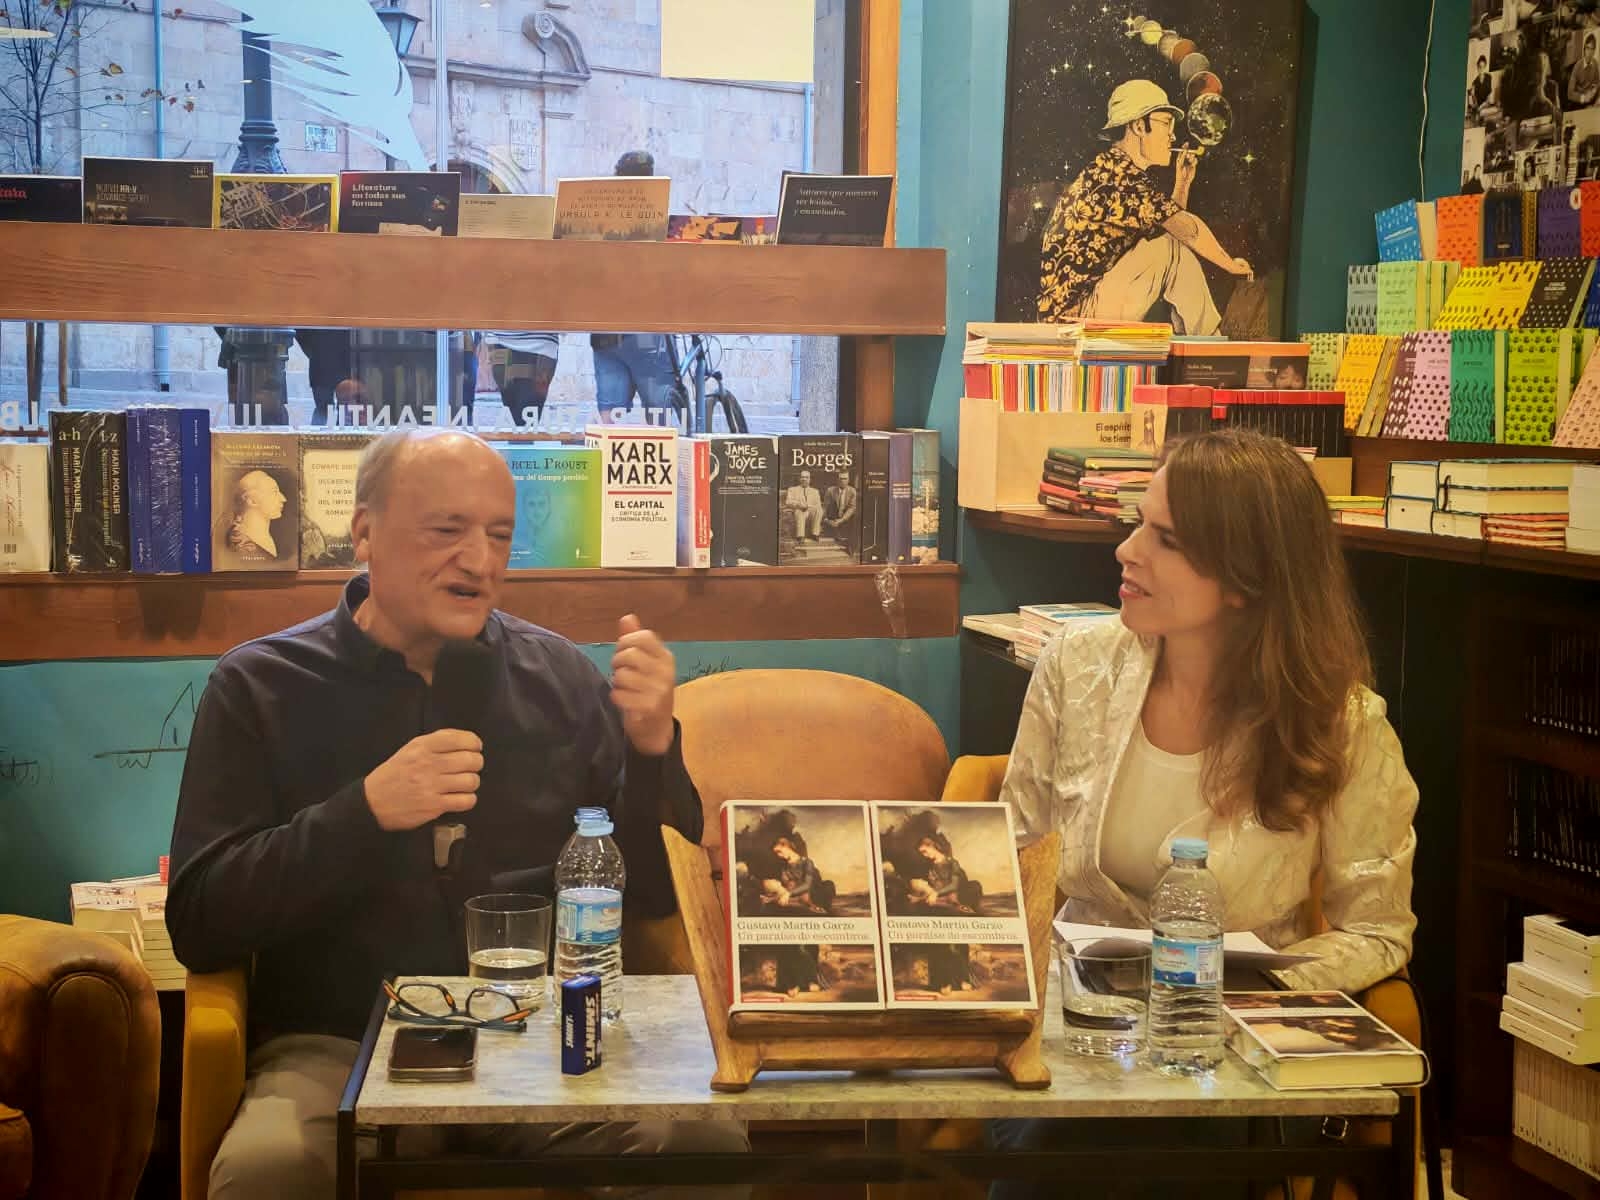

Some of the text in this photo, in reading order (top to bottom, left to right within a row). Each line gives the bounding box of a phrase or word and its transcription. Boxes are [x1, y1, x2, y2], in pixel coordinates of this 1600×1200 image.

[559, 208, 600, 217] URSULA
[620, 209, 633, 219] LE
[59, 427, 81, 441] a-h
[100, 430, 118, 443] i-z
[611, 442, 671, 463] KARL
[723, 441, 759, 456] JAMES
[729, 455, 768, 473] JOYCE
[791, 448, 853, 473] Borges
[607, 463, 673, 485] MARX
[112, 477, 121, 514] MOLINER
[614, 500, 665, 509] EL CAPITAL
[737, 920, 855, 930] Gustavo Martín Garzo
[887, 920, 1003, 930] Gustavo Martín Garzo
[738, 932, 753, 941] Un
[755, 932, 797, 943] paraíso
[888, 931, 904, 940] Un
[585, 995, 596, 1060] SMINT
